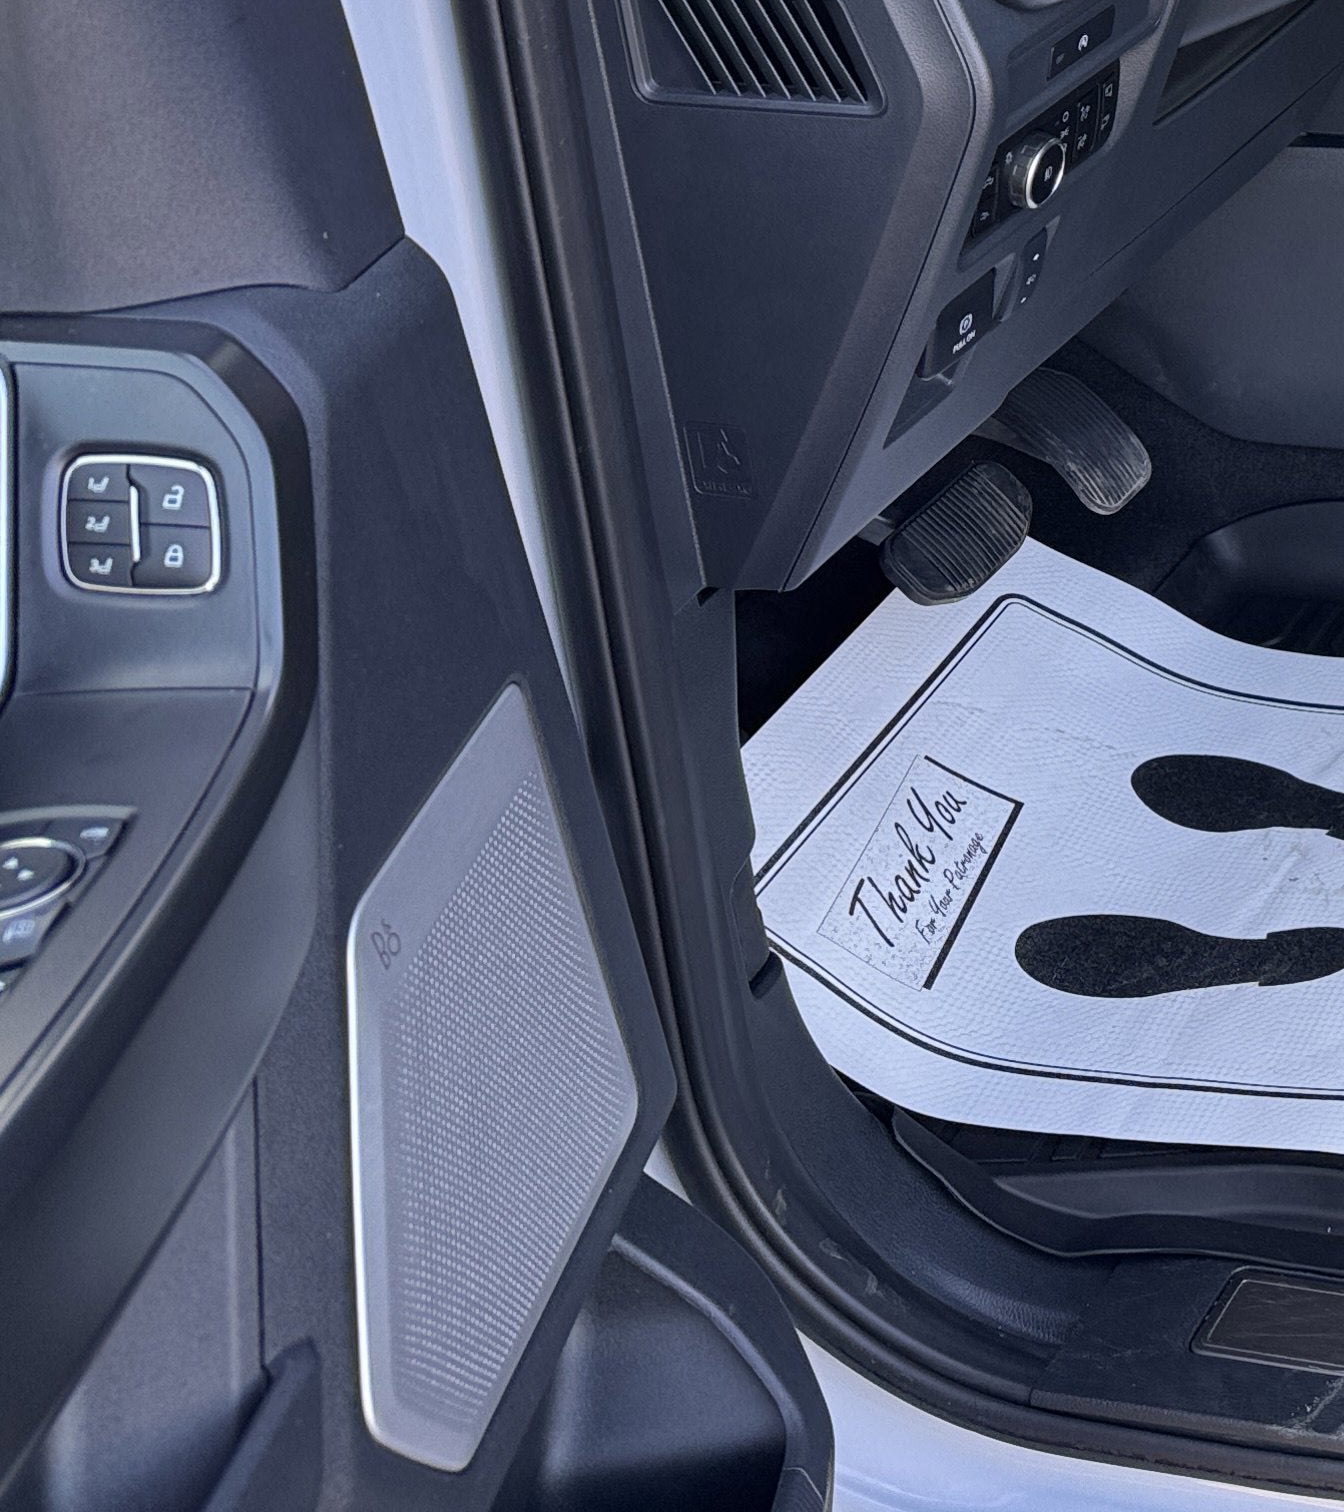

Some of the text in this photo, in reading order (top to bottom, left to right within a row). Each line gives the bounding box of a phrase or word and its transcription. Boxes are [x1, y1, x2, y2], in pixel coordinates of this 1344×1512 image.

[952, 329, 977, 354] PULL ON
[849, 786, 968, 948] Thank You
[915, 832, 988, 945] For Your Patronage
